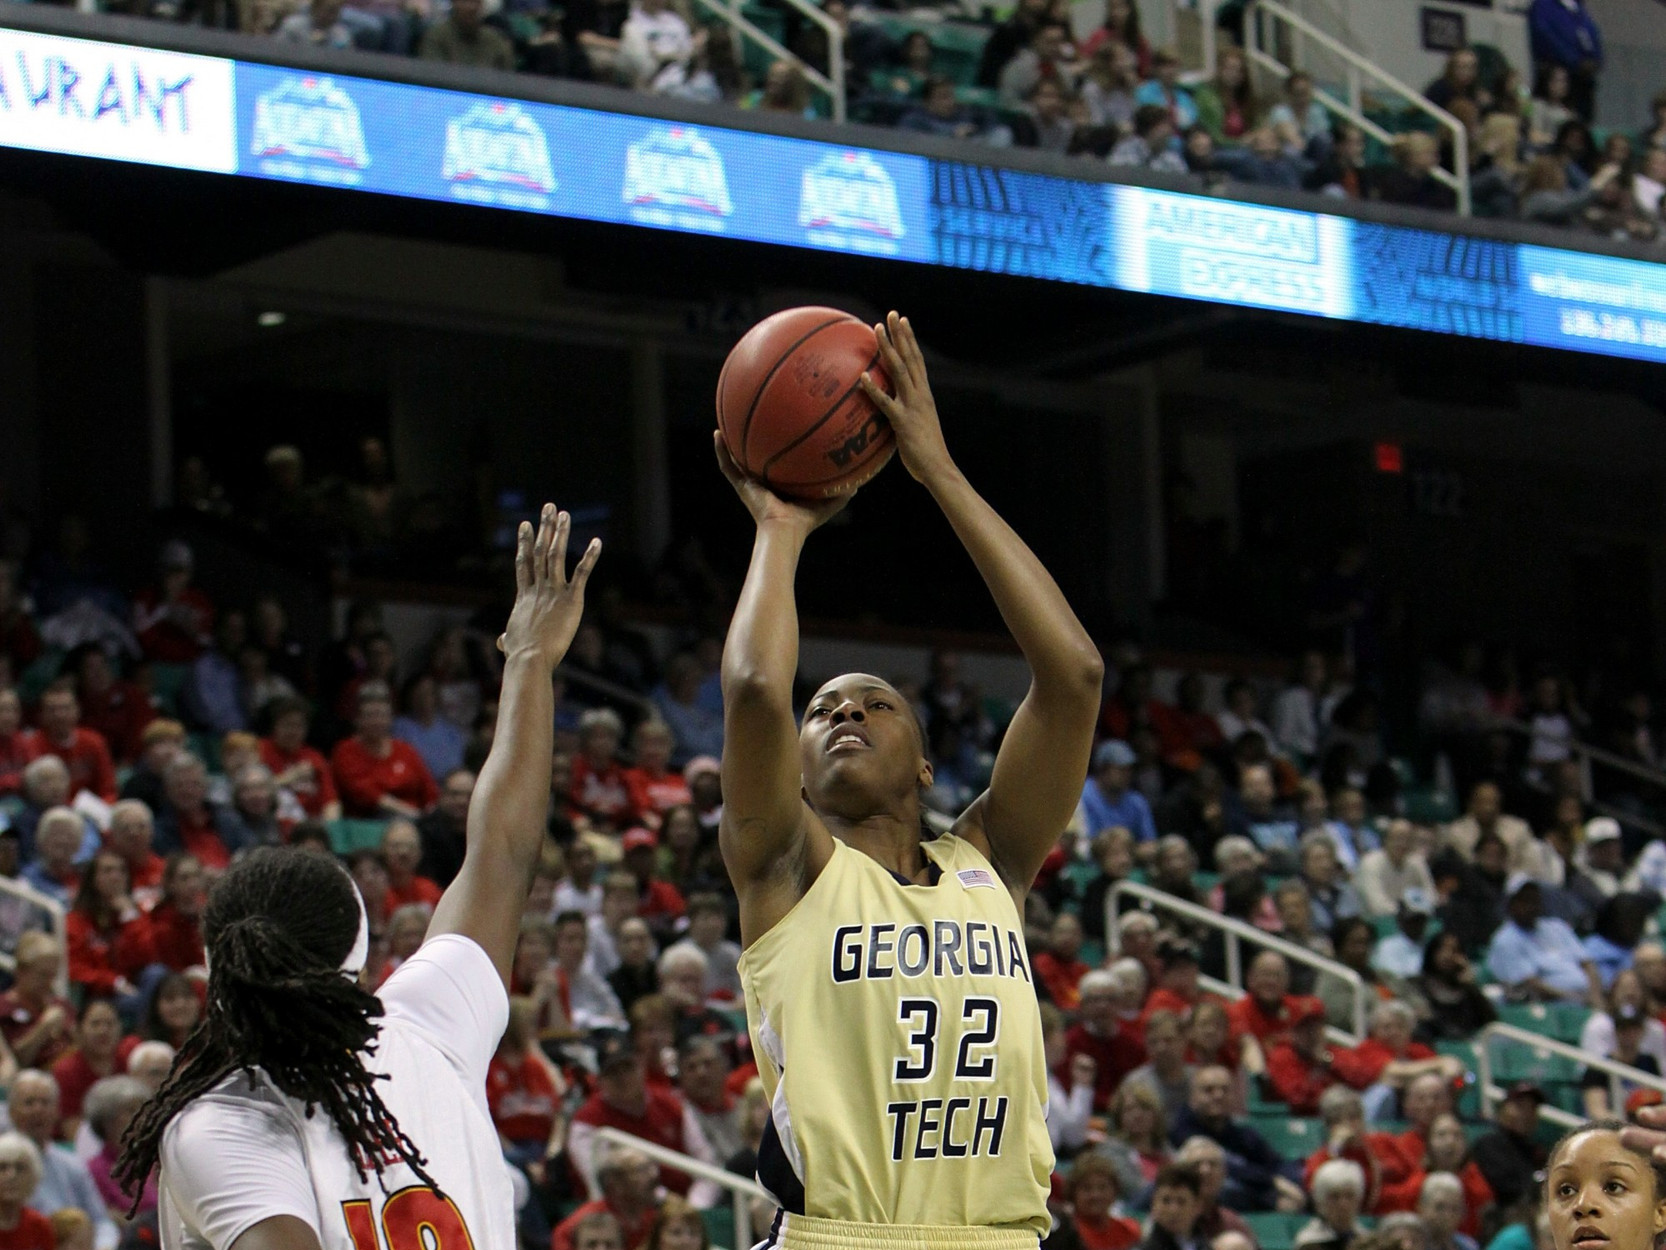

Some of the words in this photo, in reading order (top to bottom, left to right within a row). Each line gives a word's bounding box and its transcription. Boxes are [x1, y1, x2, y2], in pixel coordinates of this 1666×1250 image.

[832, 919, 1033, 984] GEORGIA
[892, 996, 1002, 1084] 32
[886, 1096, 1009, 1162] TECH
